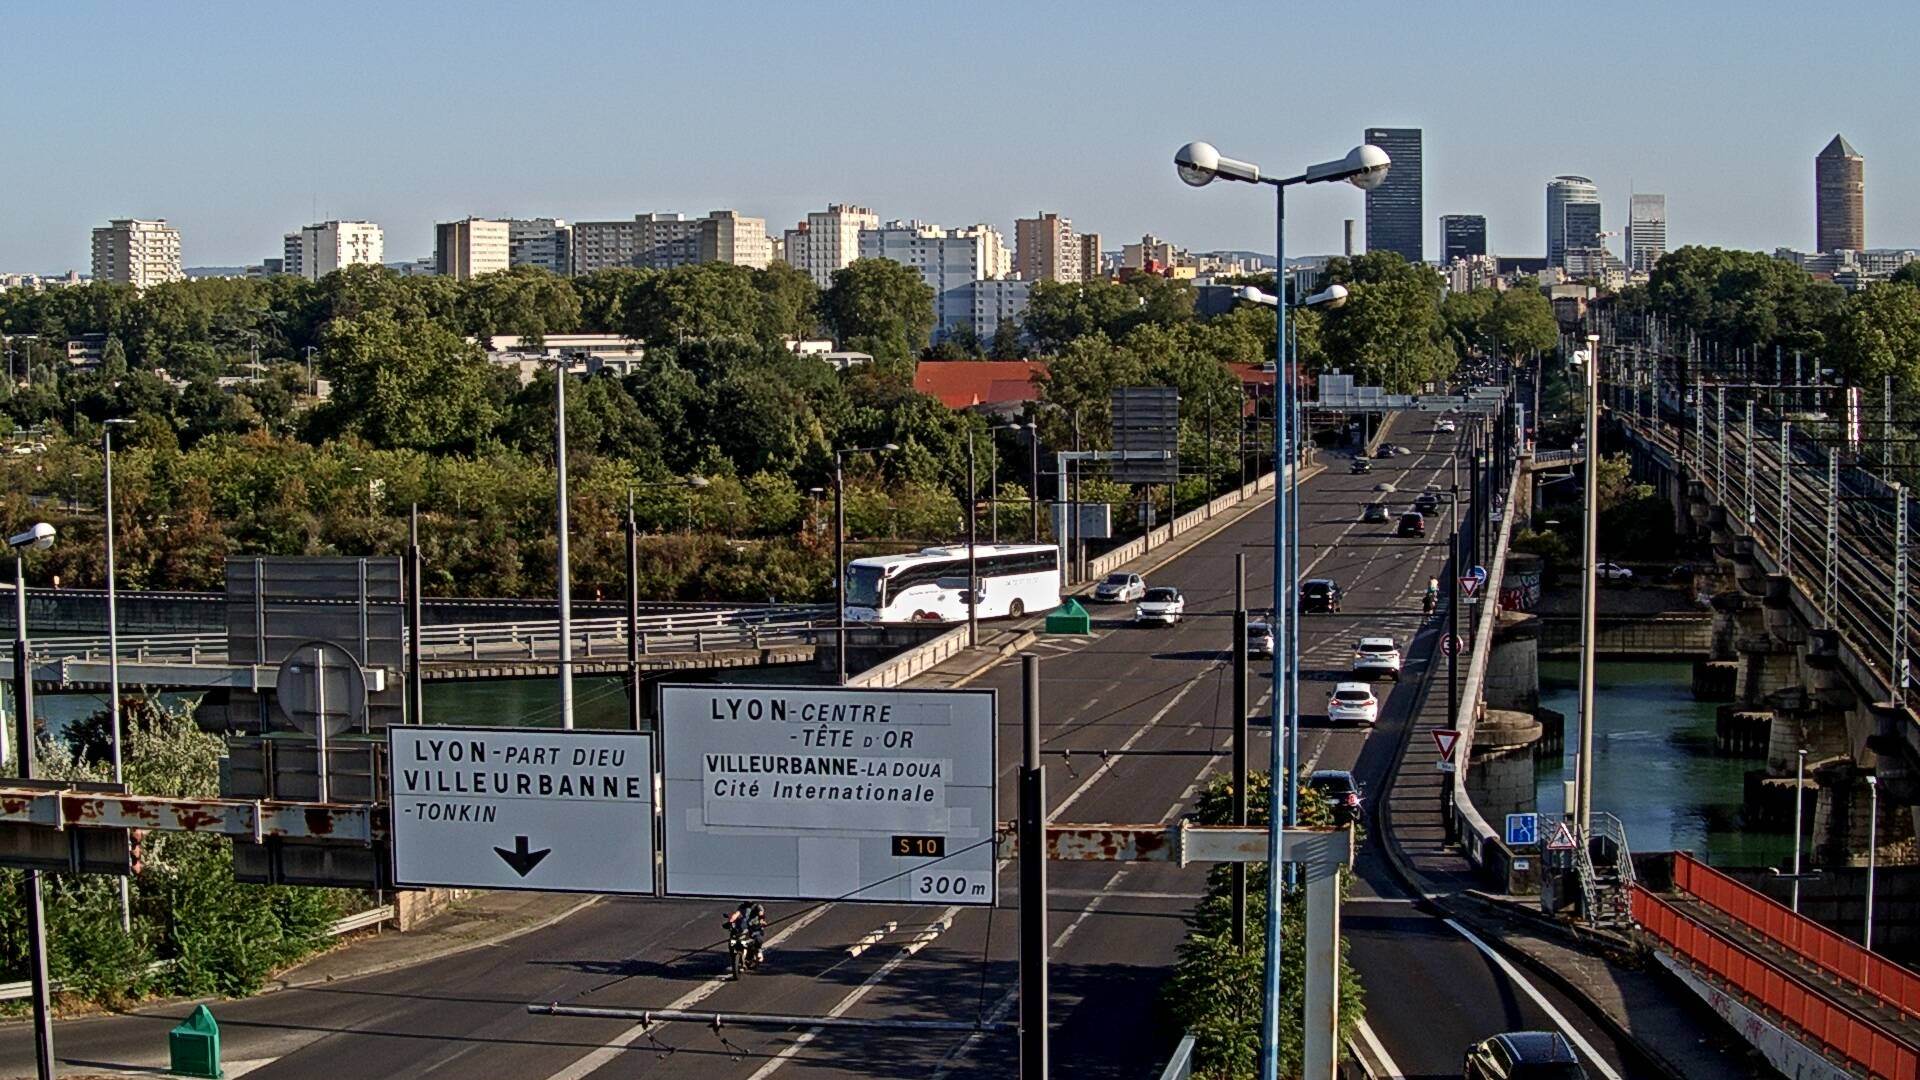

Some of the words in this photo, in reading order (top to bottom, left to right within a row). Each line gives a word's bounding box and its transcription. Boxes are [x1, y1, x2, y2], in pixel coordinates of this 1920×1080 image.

[572, 748, 625, 767] DIEU
[892, 762, 941, 778] DOUA
[403, 769, 641, 799] VILLEURBANNE
[714, 779, 759, 797] Cité
[773, 780, 934, 802] Internationale
[900, 839, 910, 853] S
[916, 839, 937, 854] 10
[919, 876, 967, 895] 300
[971, 884, 986, 895] m
